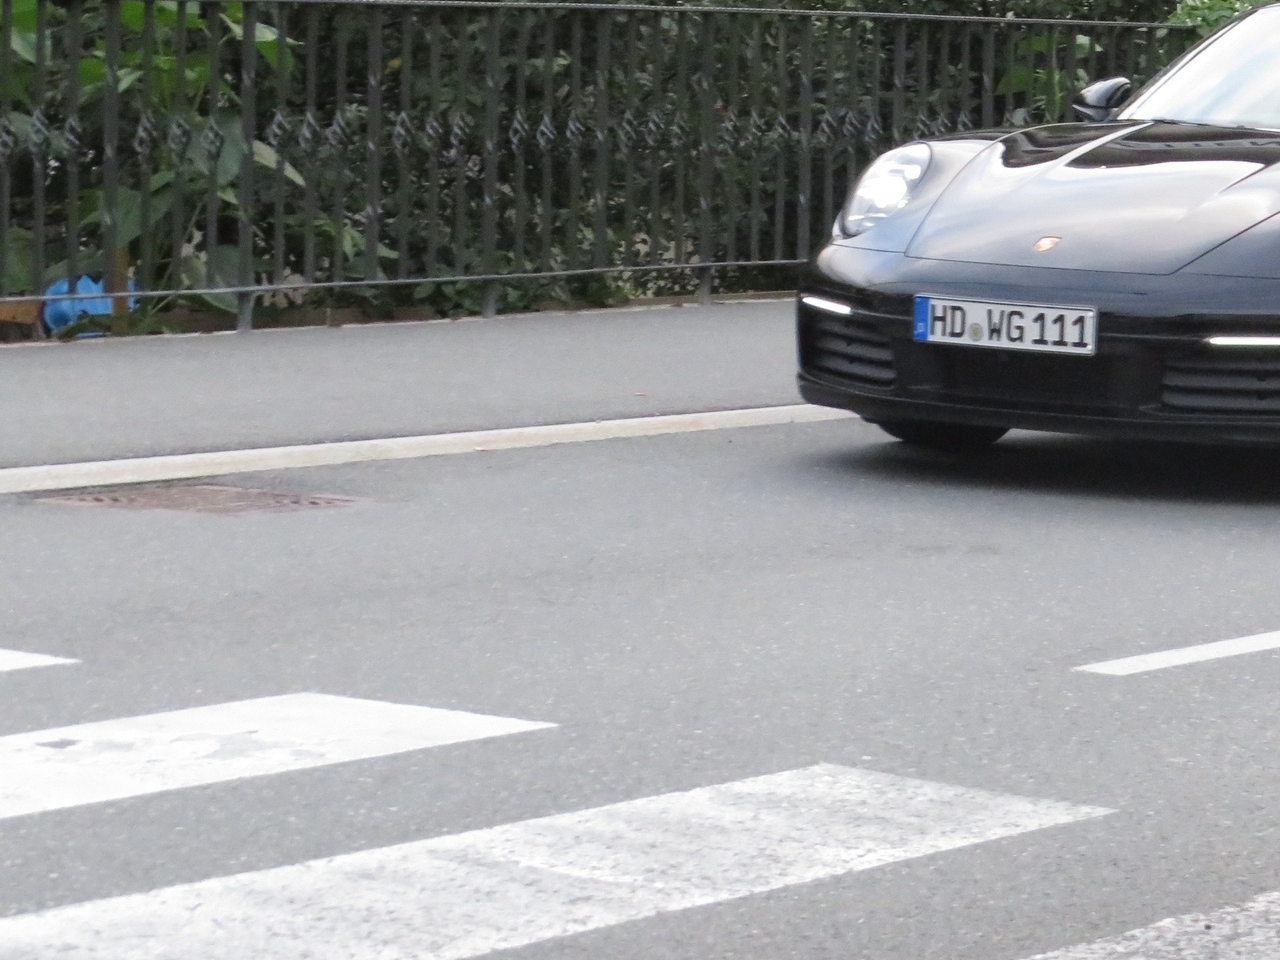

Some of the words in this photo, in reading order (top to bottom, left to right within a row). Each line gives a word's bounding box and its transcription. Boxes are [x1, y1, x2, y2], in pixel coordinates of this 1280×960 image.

[930, 303, 967, 338] HD
[987, 309, 1025, 343] WG
[1031, 313, 1088, 348] 111
